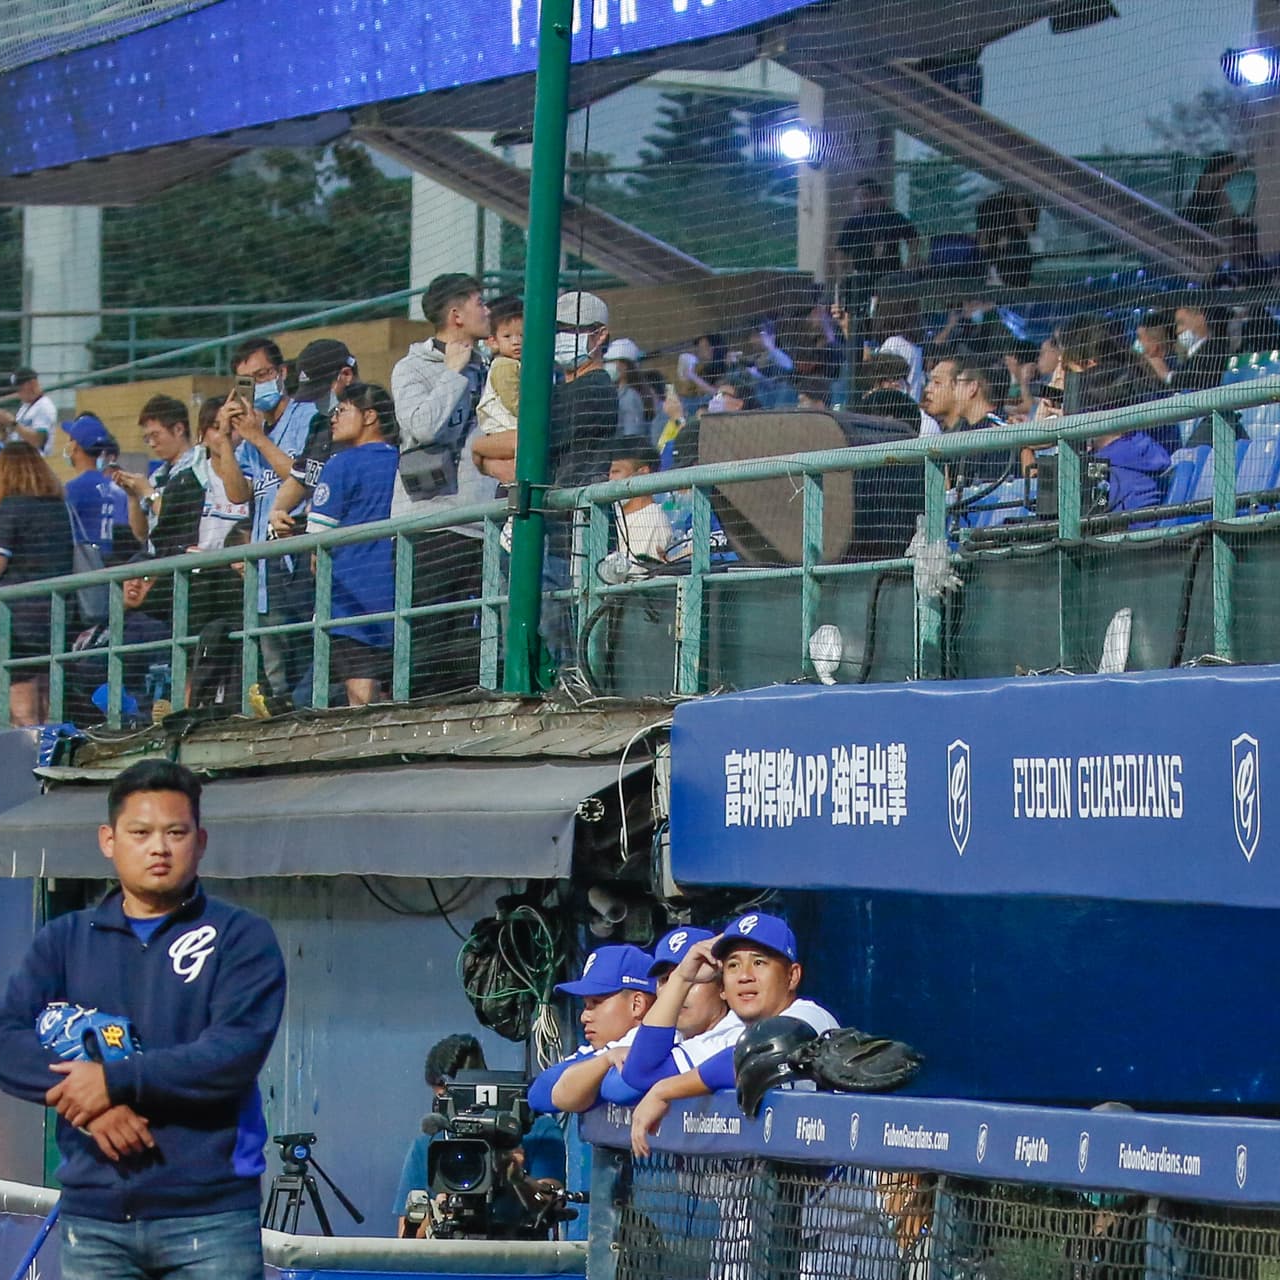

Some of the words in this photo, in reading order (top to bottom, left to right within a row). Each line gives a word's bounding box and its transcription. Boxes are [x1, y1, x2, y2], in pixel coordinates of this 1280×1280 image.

[1012, 757, 1072, 819] FUBON
[1077, 754, 1184, 819] GUARDIANS
[481, 1090, 490, 1106] 1
[883, 1122, 950, 1151] FubonGuardians.com
[1118, 1142, 1201, 1176] FubonGuardians.com
